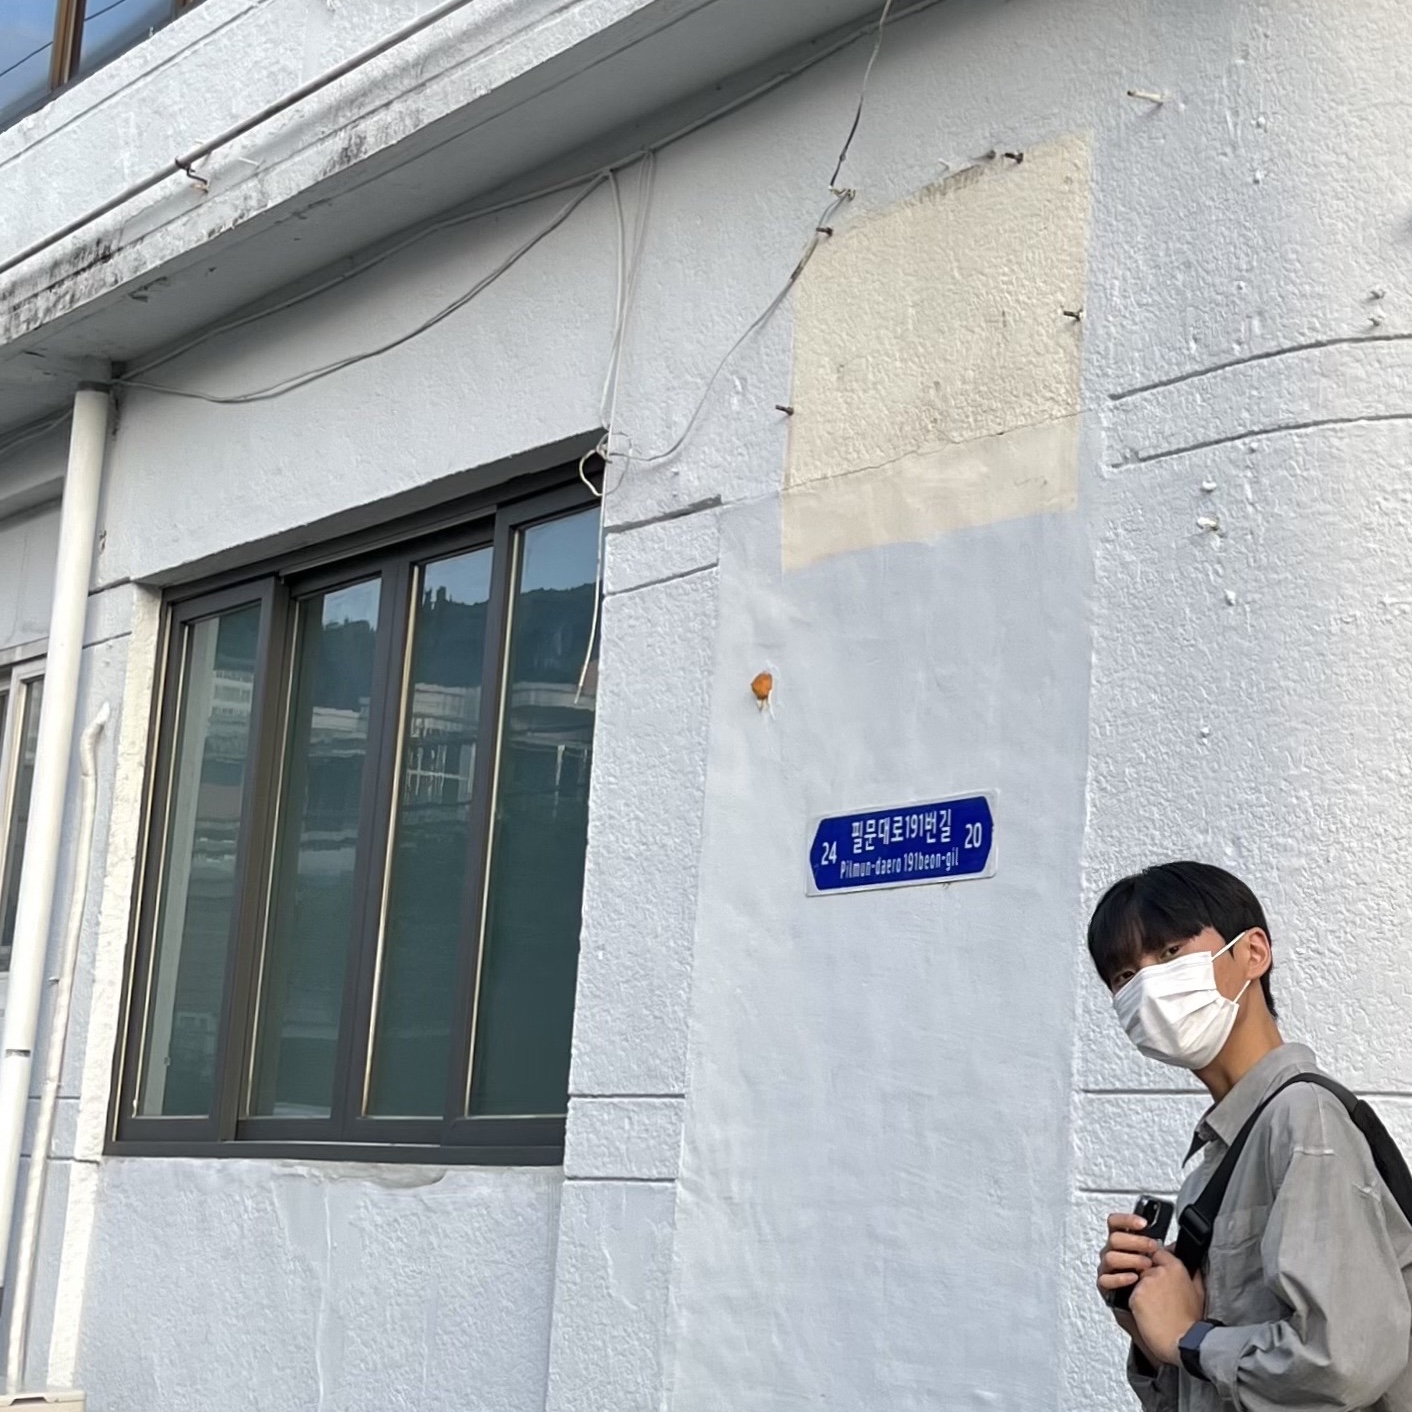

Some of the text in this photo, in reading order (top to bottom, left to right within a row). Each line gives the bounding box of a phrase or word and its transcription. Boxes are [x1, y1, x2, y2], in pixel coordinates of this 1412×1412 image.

[851, 808, 953, 854] 필문대로191번길
[964, 822, 983, 849] 20
[821, 842, 837, 866] 24
[840, 847, 959, 879] Pilmun-daero 191beon-gil
